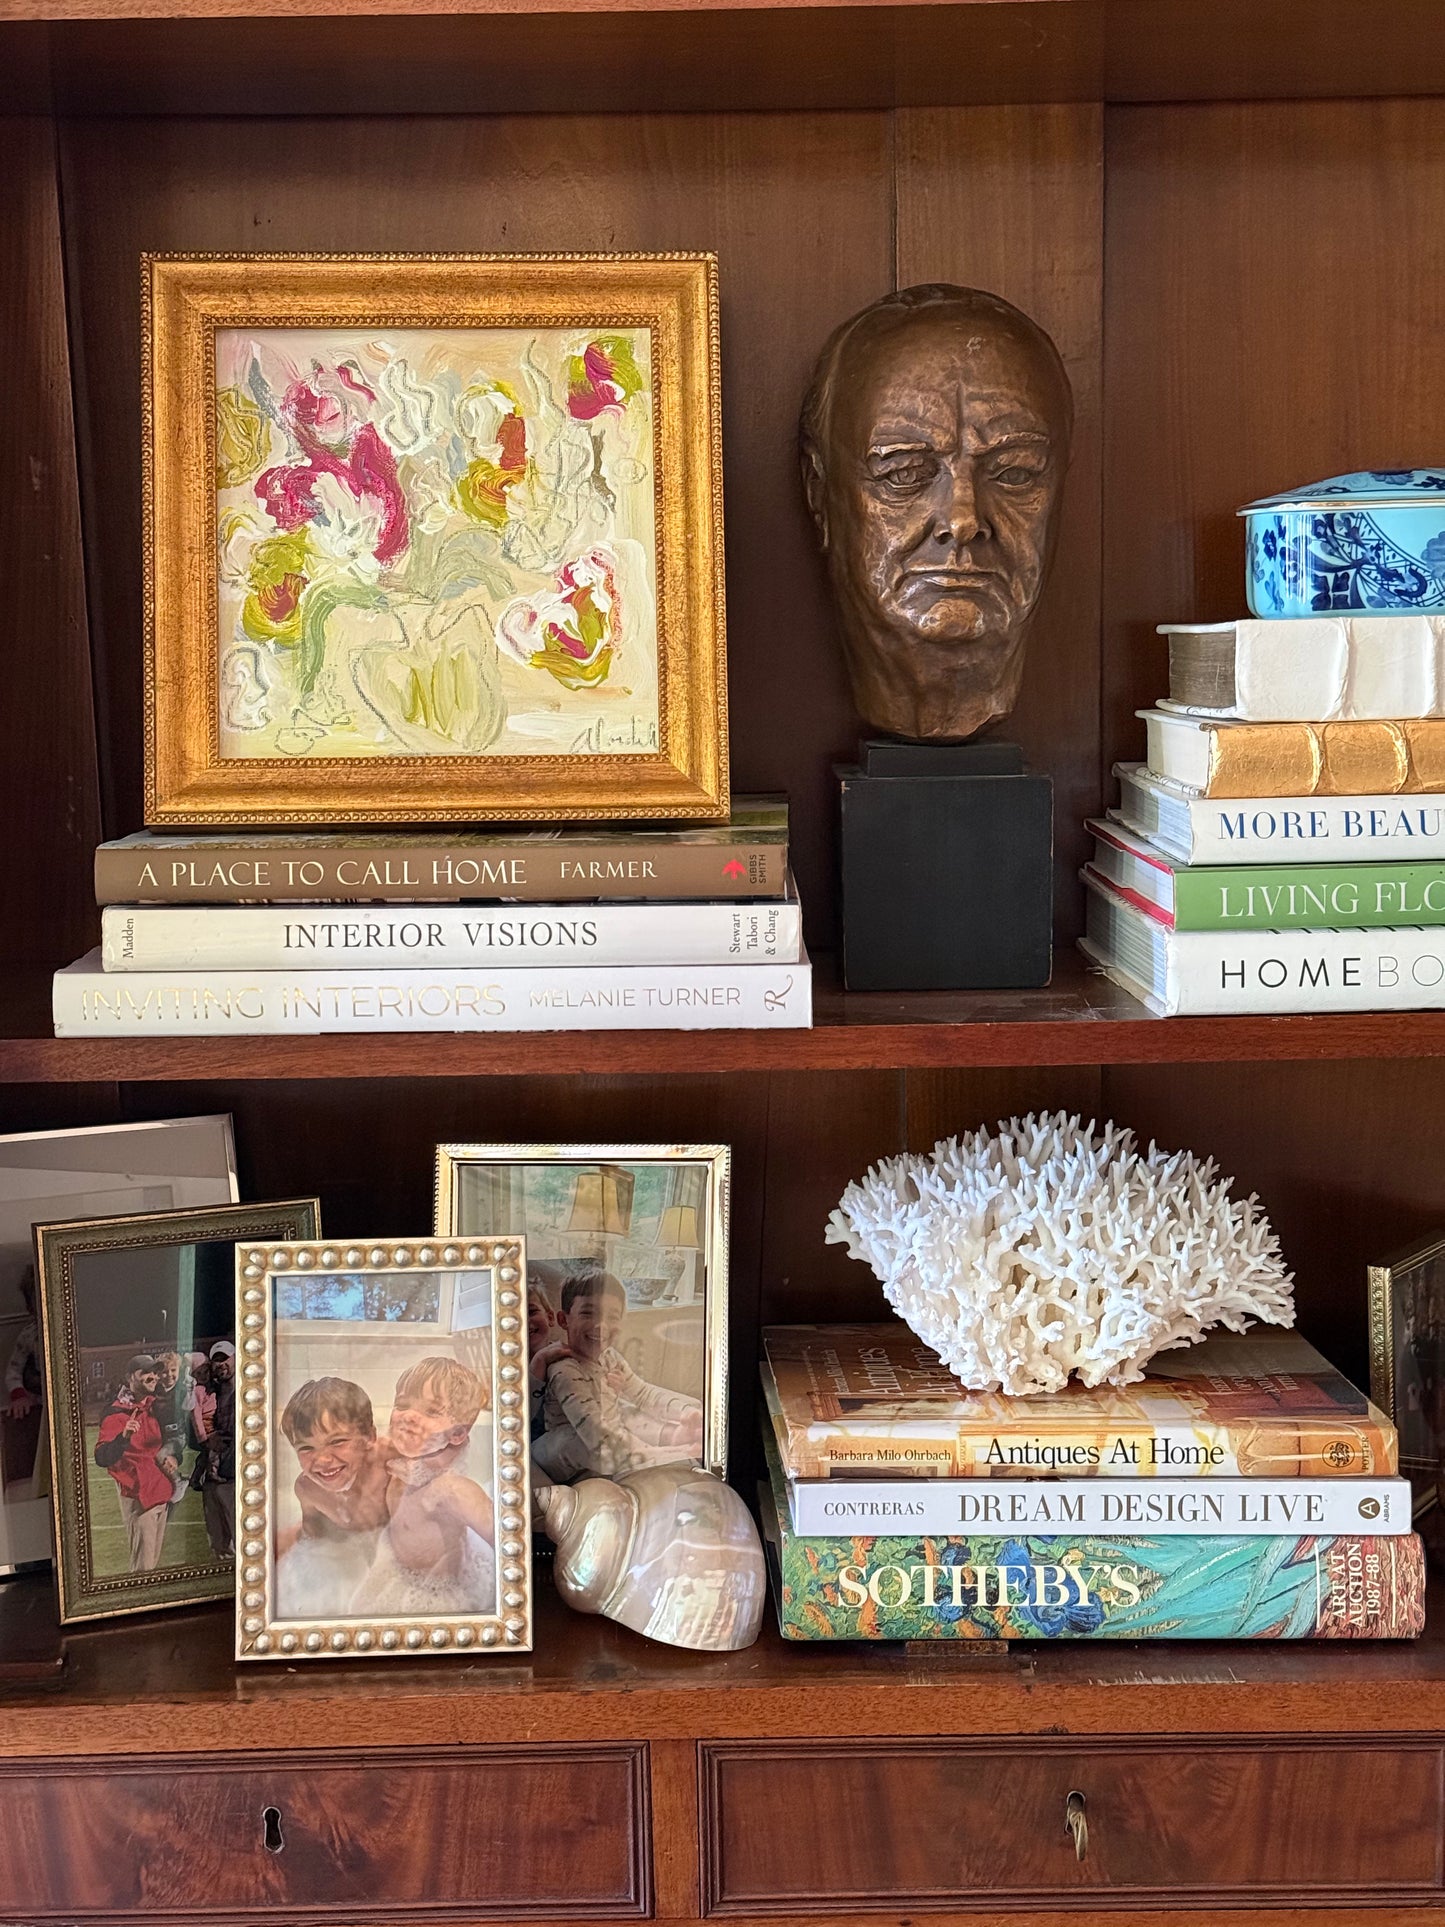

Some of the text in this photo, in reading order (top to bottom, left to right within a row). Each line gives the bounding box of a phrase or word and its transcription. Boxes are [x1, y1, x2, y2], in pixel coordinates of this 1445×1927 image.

[1218, 808, 1445, 839] MORE BEAU
[137, 859, 528, 887] A PLACE TO CALL HOME
[559, 861, 659, 879] FARMER
[758, 854, 766, 884] SMITH
[1219, 883, 1360, 918] LIVING
[121, 918, 134, 959] Madden
[283, 921, 598, 948] INTERIOR VISIONS
[729, 913, 741, 953] Stewart
[746, 916, 759, 950] Tabori
[764, 909, 779, 956] & Chang
[81, 984, 506, 1021] INVITING INTERIORS
[529, 987, 742, 1008] MELANIE TURNER
[857, 1347, 905, 1396] Antiques
[829, 1449, 952, 1461] Barbara Milo Ohrbach
[983, 1438, 1225, 1470] Antiques At Home
[1361, 1437, 1370, 1471] POTTER
[823, 1501, 926, 1517] CONTRERAS
[957, 1494, 1325, 1523] DREAM DESIGN LIVE
[837, 1564, 1141, 1608] SOTHEBY'S
[1331, 1551, 1347, 1619] ART AT
[1346, 1543, 1364, 1628] AUCTION
[1365, 1554, 1381, 1616] 1987-88
